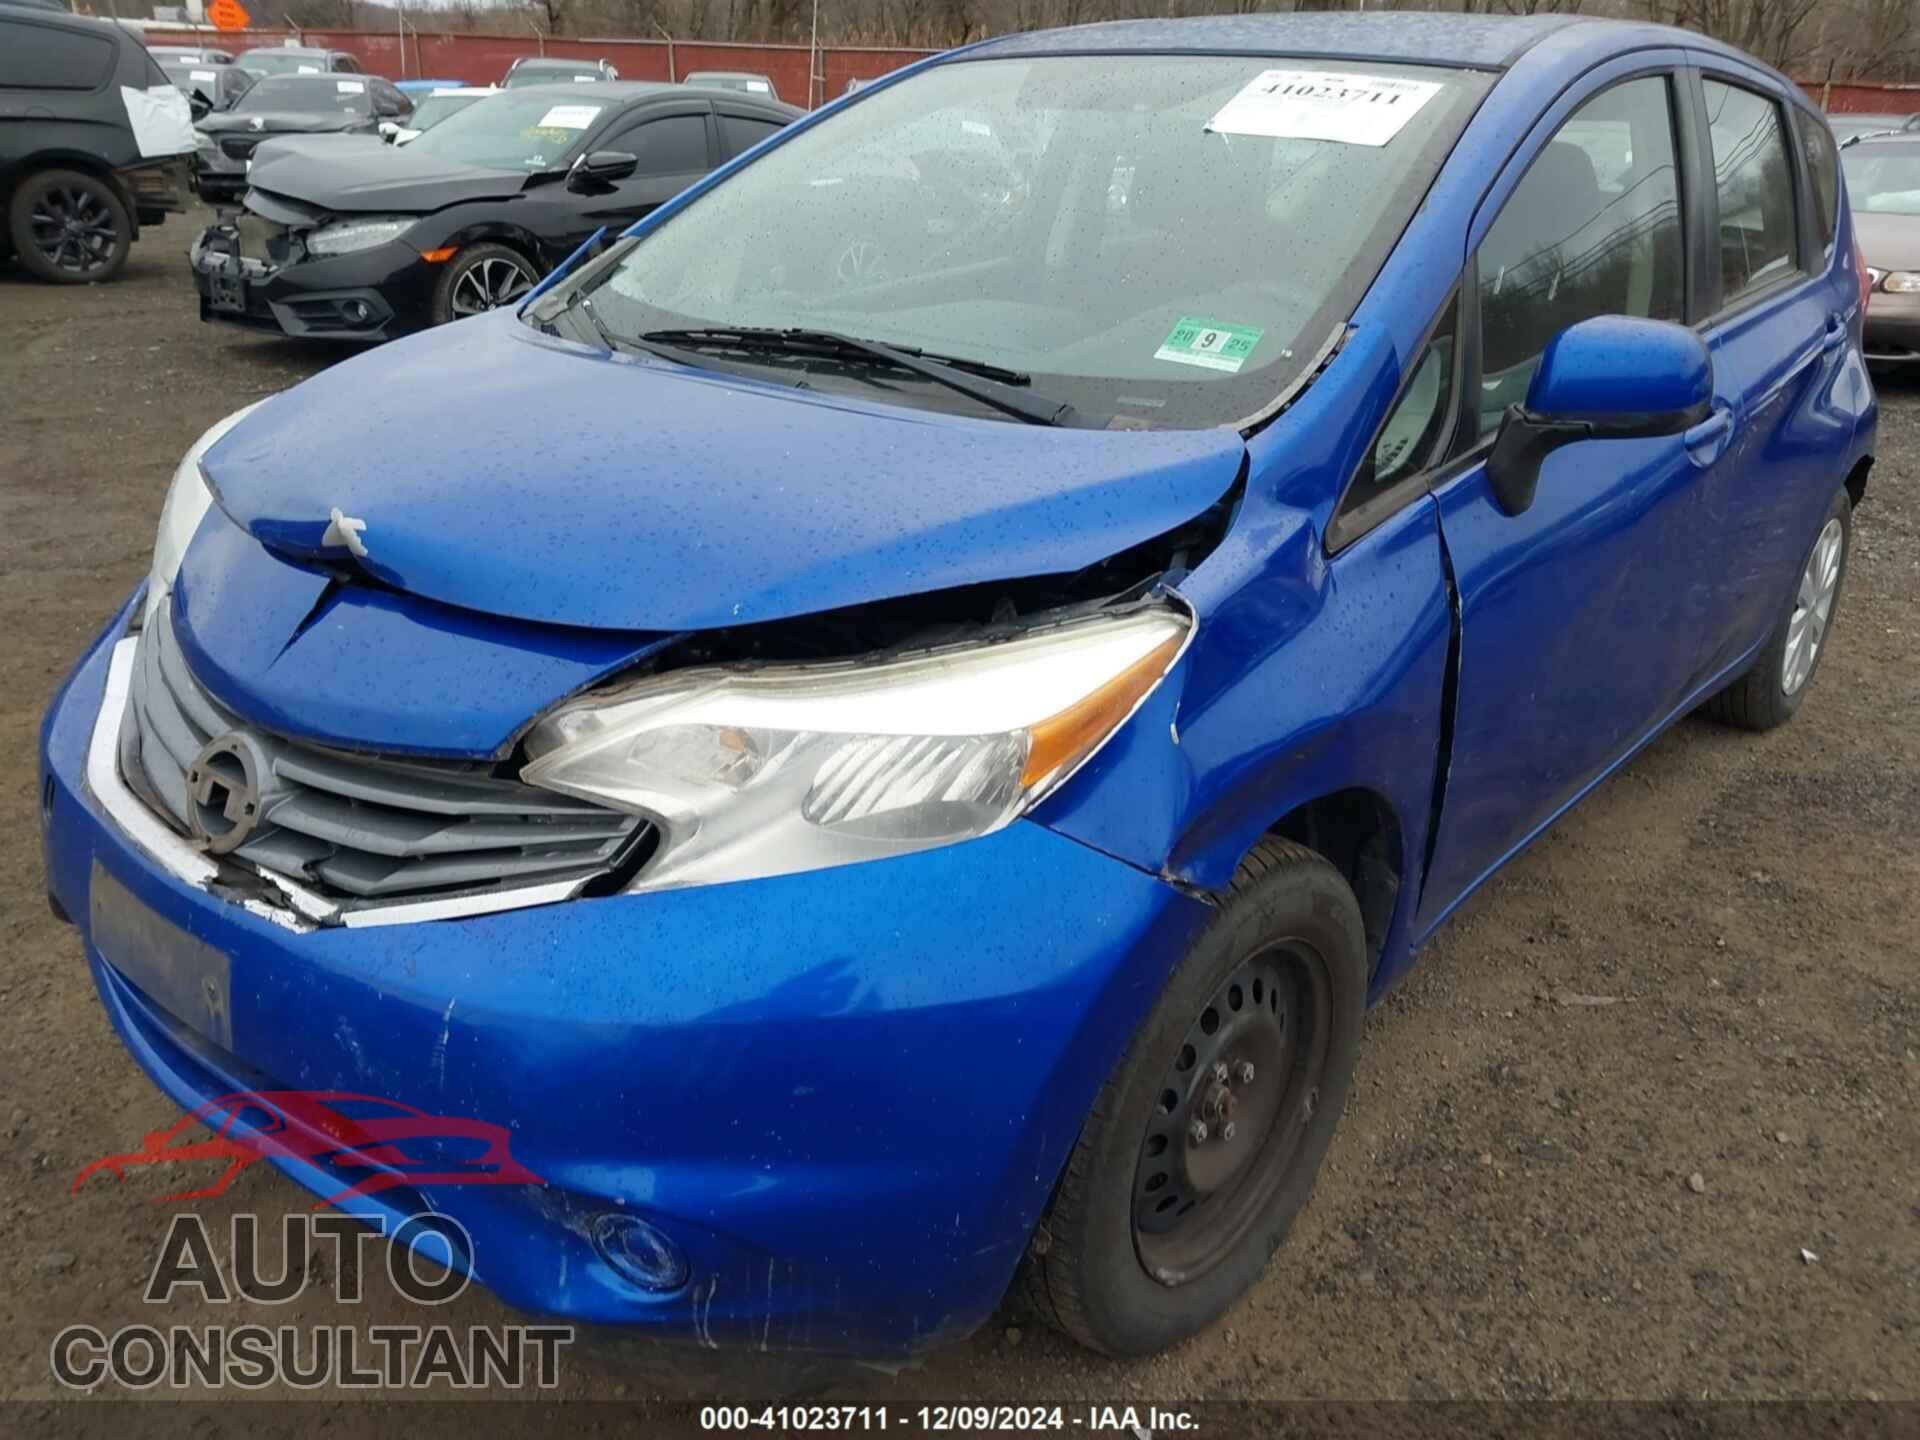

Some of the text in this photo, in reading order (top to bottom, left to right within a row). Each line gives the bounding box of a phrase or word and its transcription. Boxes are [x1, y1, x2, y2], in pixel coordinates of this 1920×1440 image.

[1261, 83, 1401, 105] 41023711
[1174, 329, 1251, 352] 20 9 25
